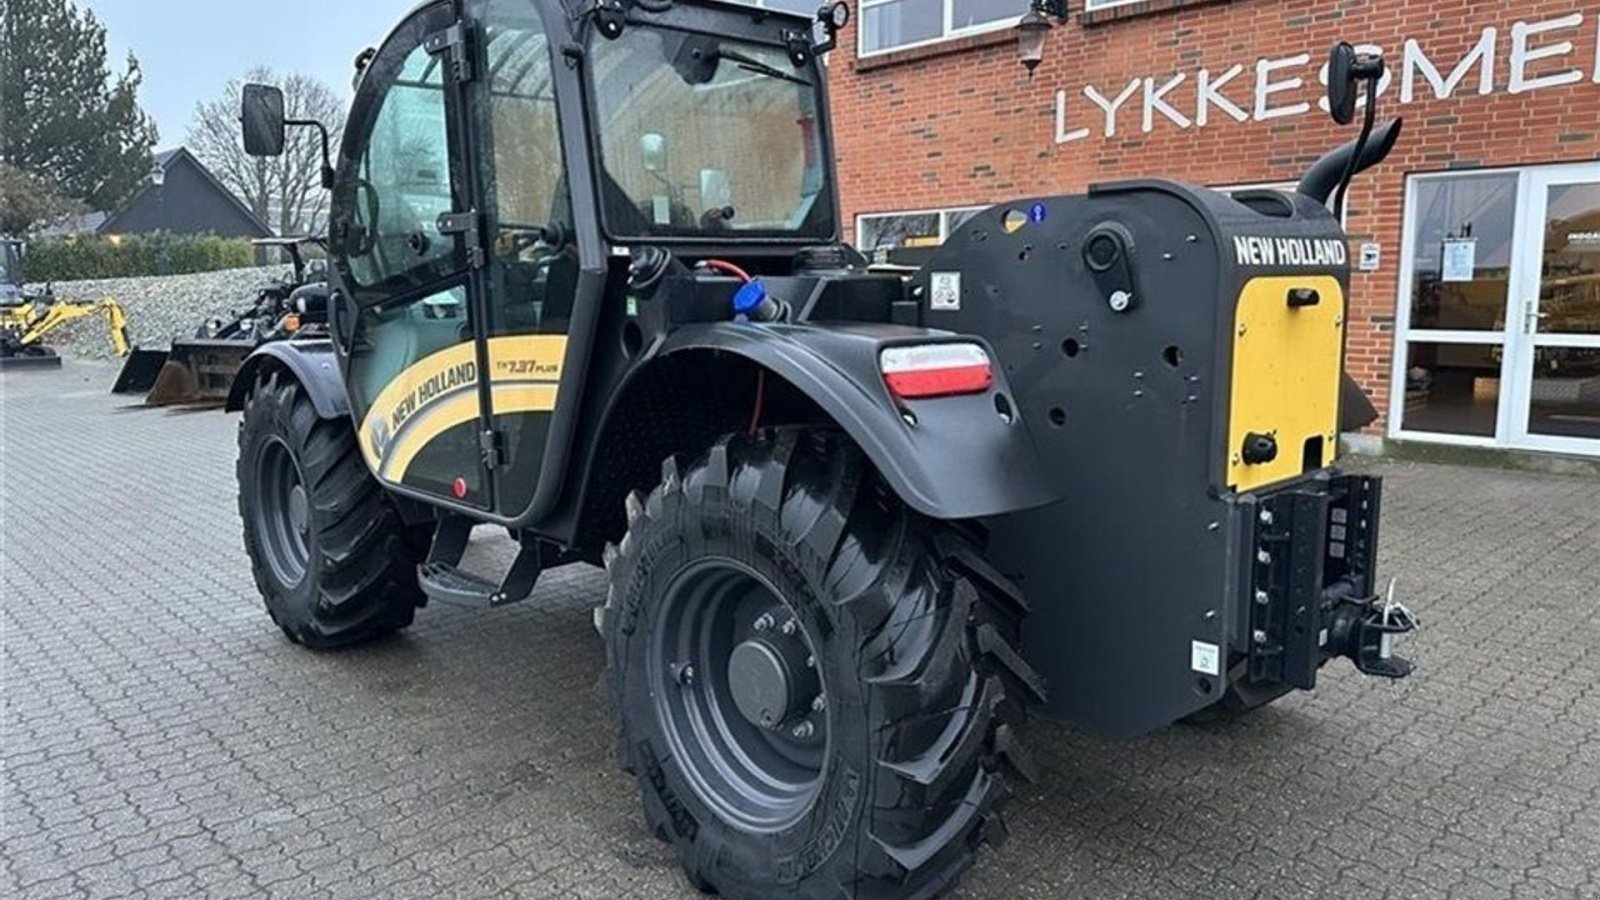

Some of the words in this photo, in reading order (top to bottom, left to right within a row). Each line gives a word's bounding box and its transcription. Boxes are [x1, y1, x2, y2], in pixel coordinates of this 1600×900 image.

[1234, 235, 1274, 265] NEW
[1275, 238, 1346, 265] HOLLAND
[393, 390, 416, 430] NEW
[418, 361, 476, 404] HOLLAND
